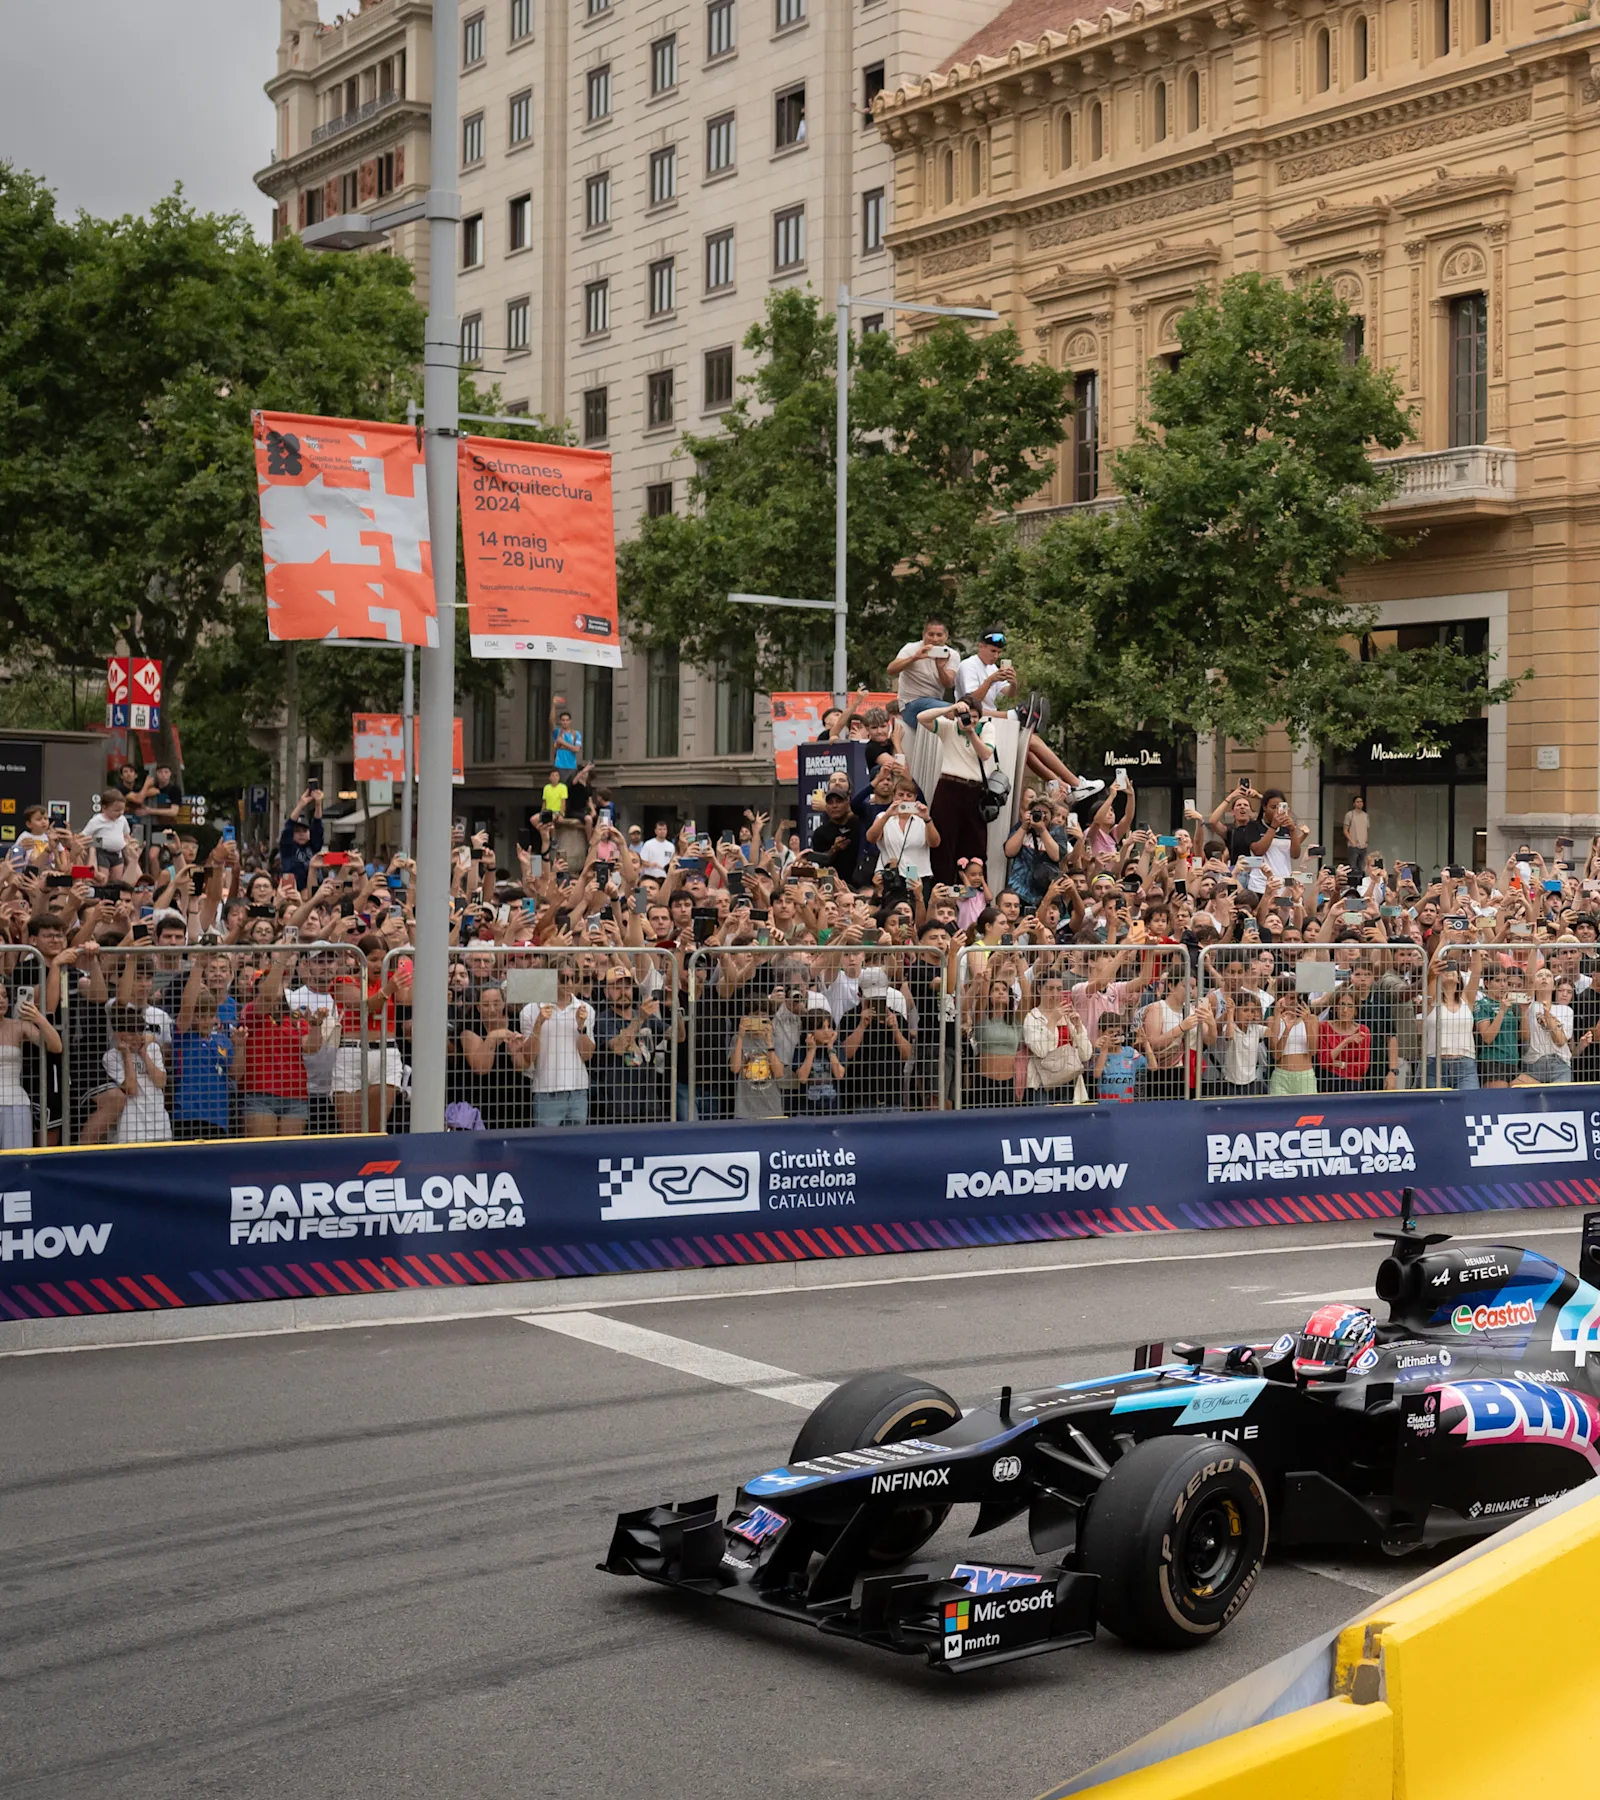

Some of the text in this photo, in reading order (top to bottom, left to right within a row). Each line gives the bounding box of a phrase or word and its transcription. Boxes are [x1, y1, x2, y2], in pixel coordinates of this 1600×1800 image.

[472, 455, 563, 479] Setmanes
[473, 476, 593, 501] d'Arquitectura
[475, 496, 521, 512] 2024
[478, 531, 547, 552] 14 maig
[502, 551, 525, 567] 28
[529, 552, 564, 573] juny
[110, 669, 118, 684] M
[144, 672, 155, 685] M
[805, 755, 847, 768] BARCELONA
[1104, 749, 1162, 766] Massimo Dutti
[253, 788, 265, 803] P
[1001, 1135, 1074, 1165] LIVE
[1206, 1125, 1415, 1164] BARCELONA
[768, 1148, 856, 1170] Circuit de
[1207, 1153, 1416, 1184] FAN FESTIVAL 2024
[768, 1168, 856, 1191] Barcelona
[945, 1163, 1128, 1200] ROADSHOW
[230, 1171, 524, 1222] BARCELONA
[768, 1190, 856, 1210] CATALUNYA
[230, 1205, 526, 1246] FAN FESTIVAL 2024
[1464, 1254, 1496, 1267] RENAULT
[1459, 1264, 1509, 1283] E-TECH
[1473, 1298, 1536, 1331] Castrol
[1397, 1353, 1437, 1369] ultimate
[1447, 1378, 1592, 1448] BWT
[871, 1467, 950, 1494] INFINOX
[1161, 1458, 1234, 1562] P ZERO
[1484, 1496, 1530, 1514] BINANCE
[974, 1589, 1054, 1622] Micosoft
[964, 1632, 1000, 1651] mntn
